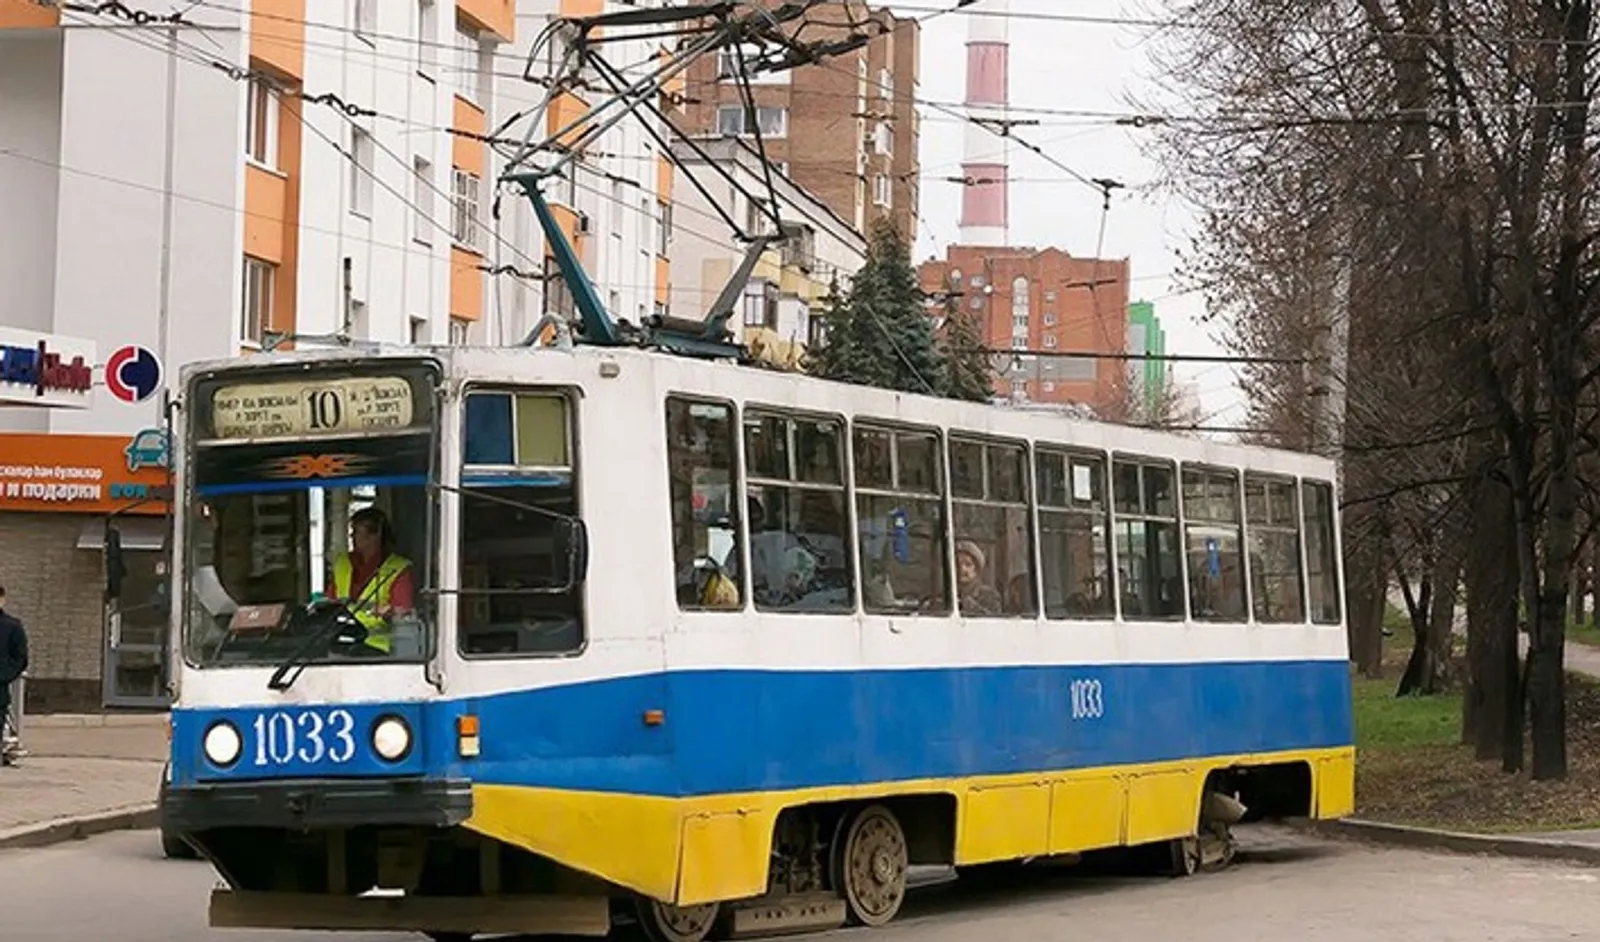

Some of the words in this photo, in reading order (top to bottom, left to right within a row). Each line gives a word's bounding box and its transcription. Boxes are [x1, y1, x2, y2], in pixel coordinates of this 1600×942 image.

[308, 391, 341, 428] 10
[22, 483, 101, 501] подарки
[1071, 679, 1103, 718] 1033
[254, 710, 355, 764] 1033
